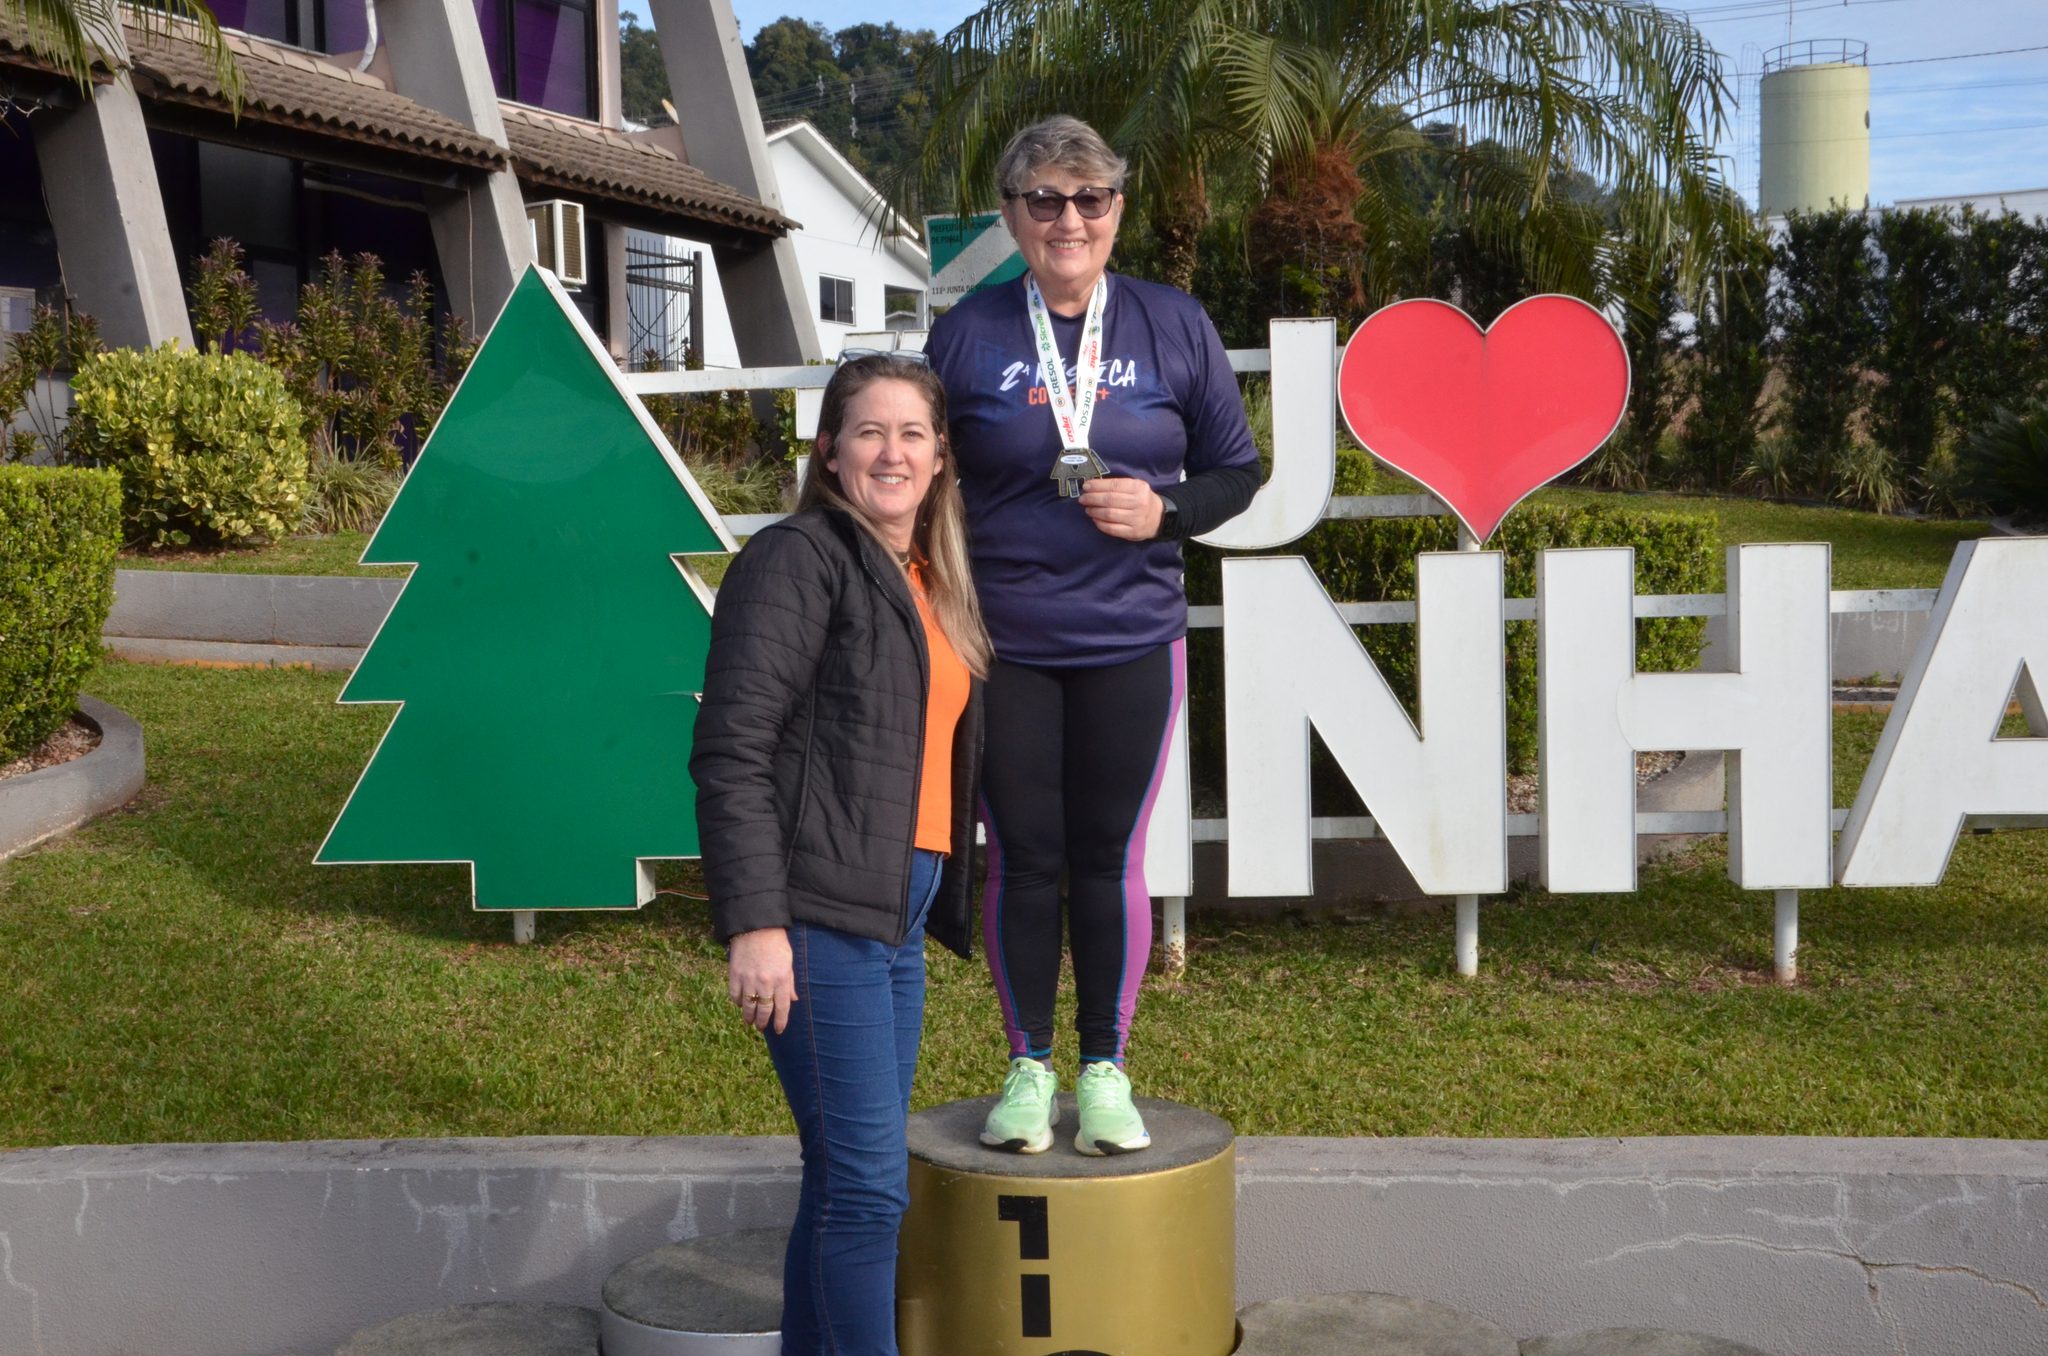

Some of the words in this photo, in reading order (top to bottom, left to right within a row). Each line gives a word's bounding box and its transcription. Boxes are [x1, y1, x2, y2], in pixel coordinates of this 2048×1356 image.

[946, 285, 966, 294] JUNTA
[1036, 312, 1048, 341] Sicredi
[1046, 358, 1061, 395] CRESOL
[1079, 390, 1092, 429] CRESOL
[1062, 414, 1075, 443] creluz
